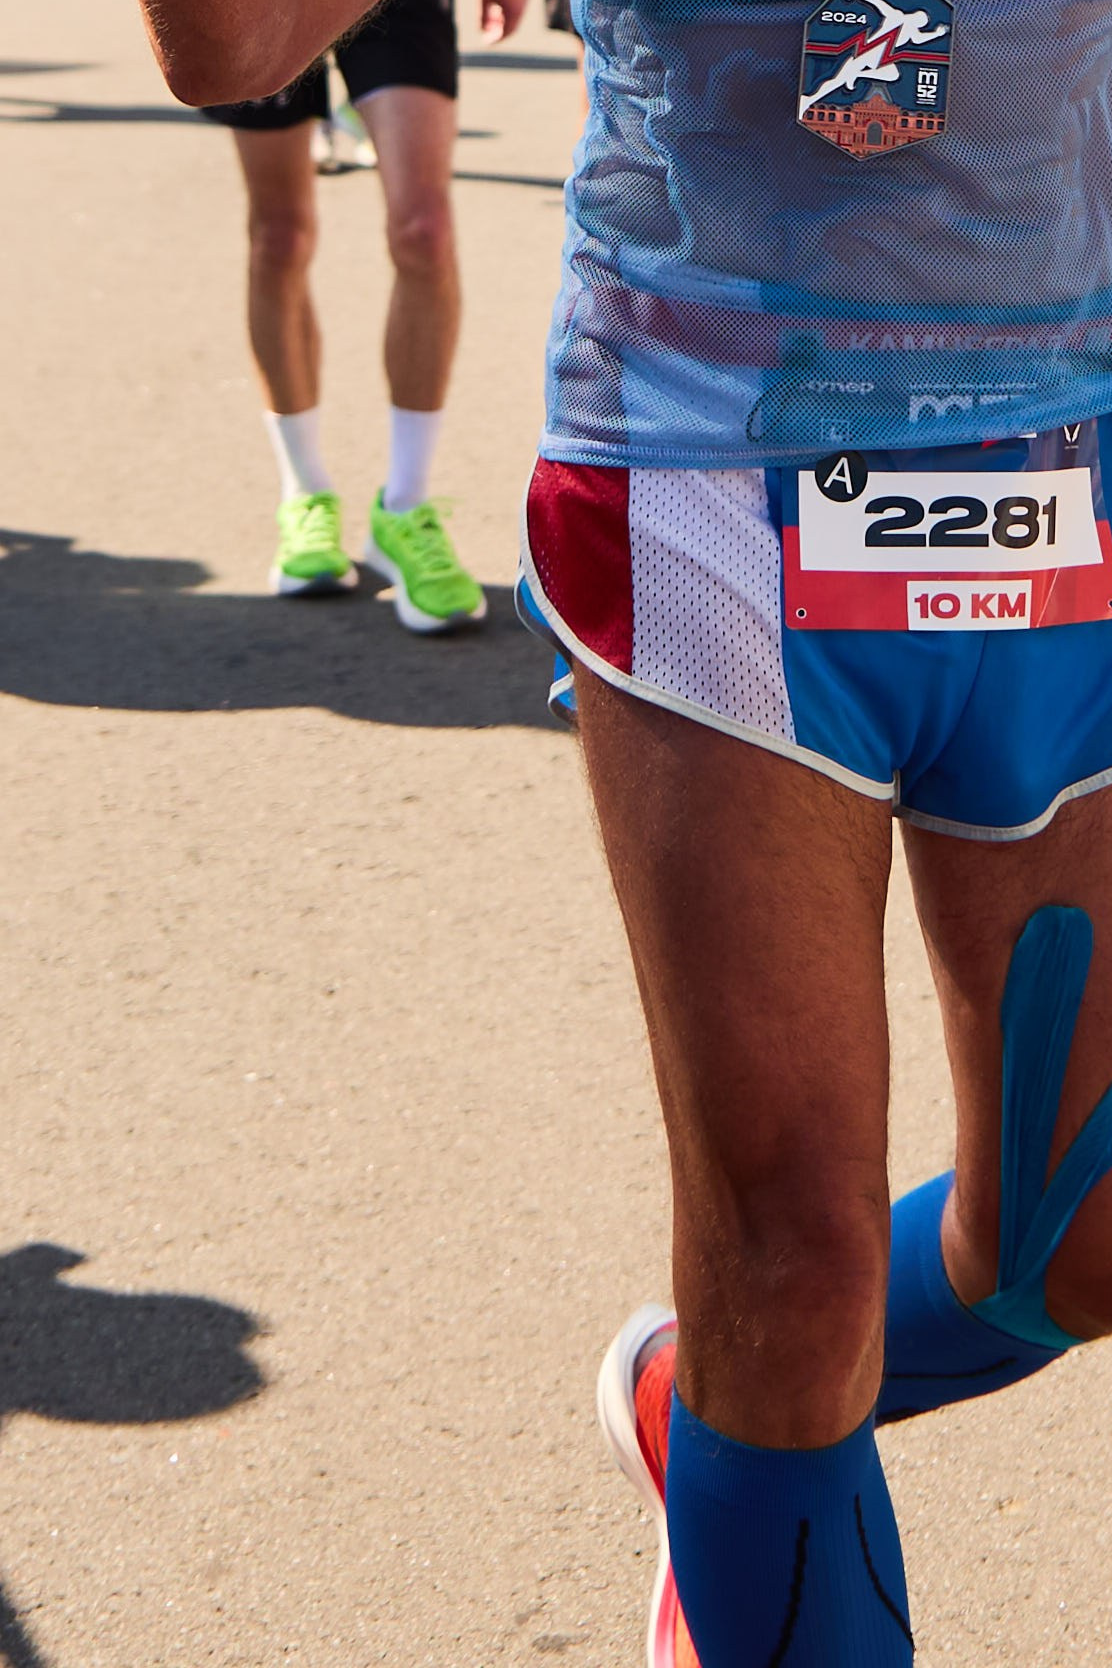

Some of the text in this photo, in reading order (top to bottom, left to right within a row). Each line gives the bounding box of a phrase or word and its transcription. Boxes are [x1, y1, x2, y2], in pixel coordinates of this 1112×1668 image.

[821, 11, 868, 25] 2024
[823, 456, 853, 494] A
[864, 495, 1057, 549] 2281
[914, 593, 961, 619] 10
